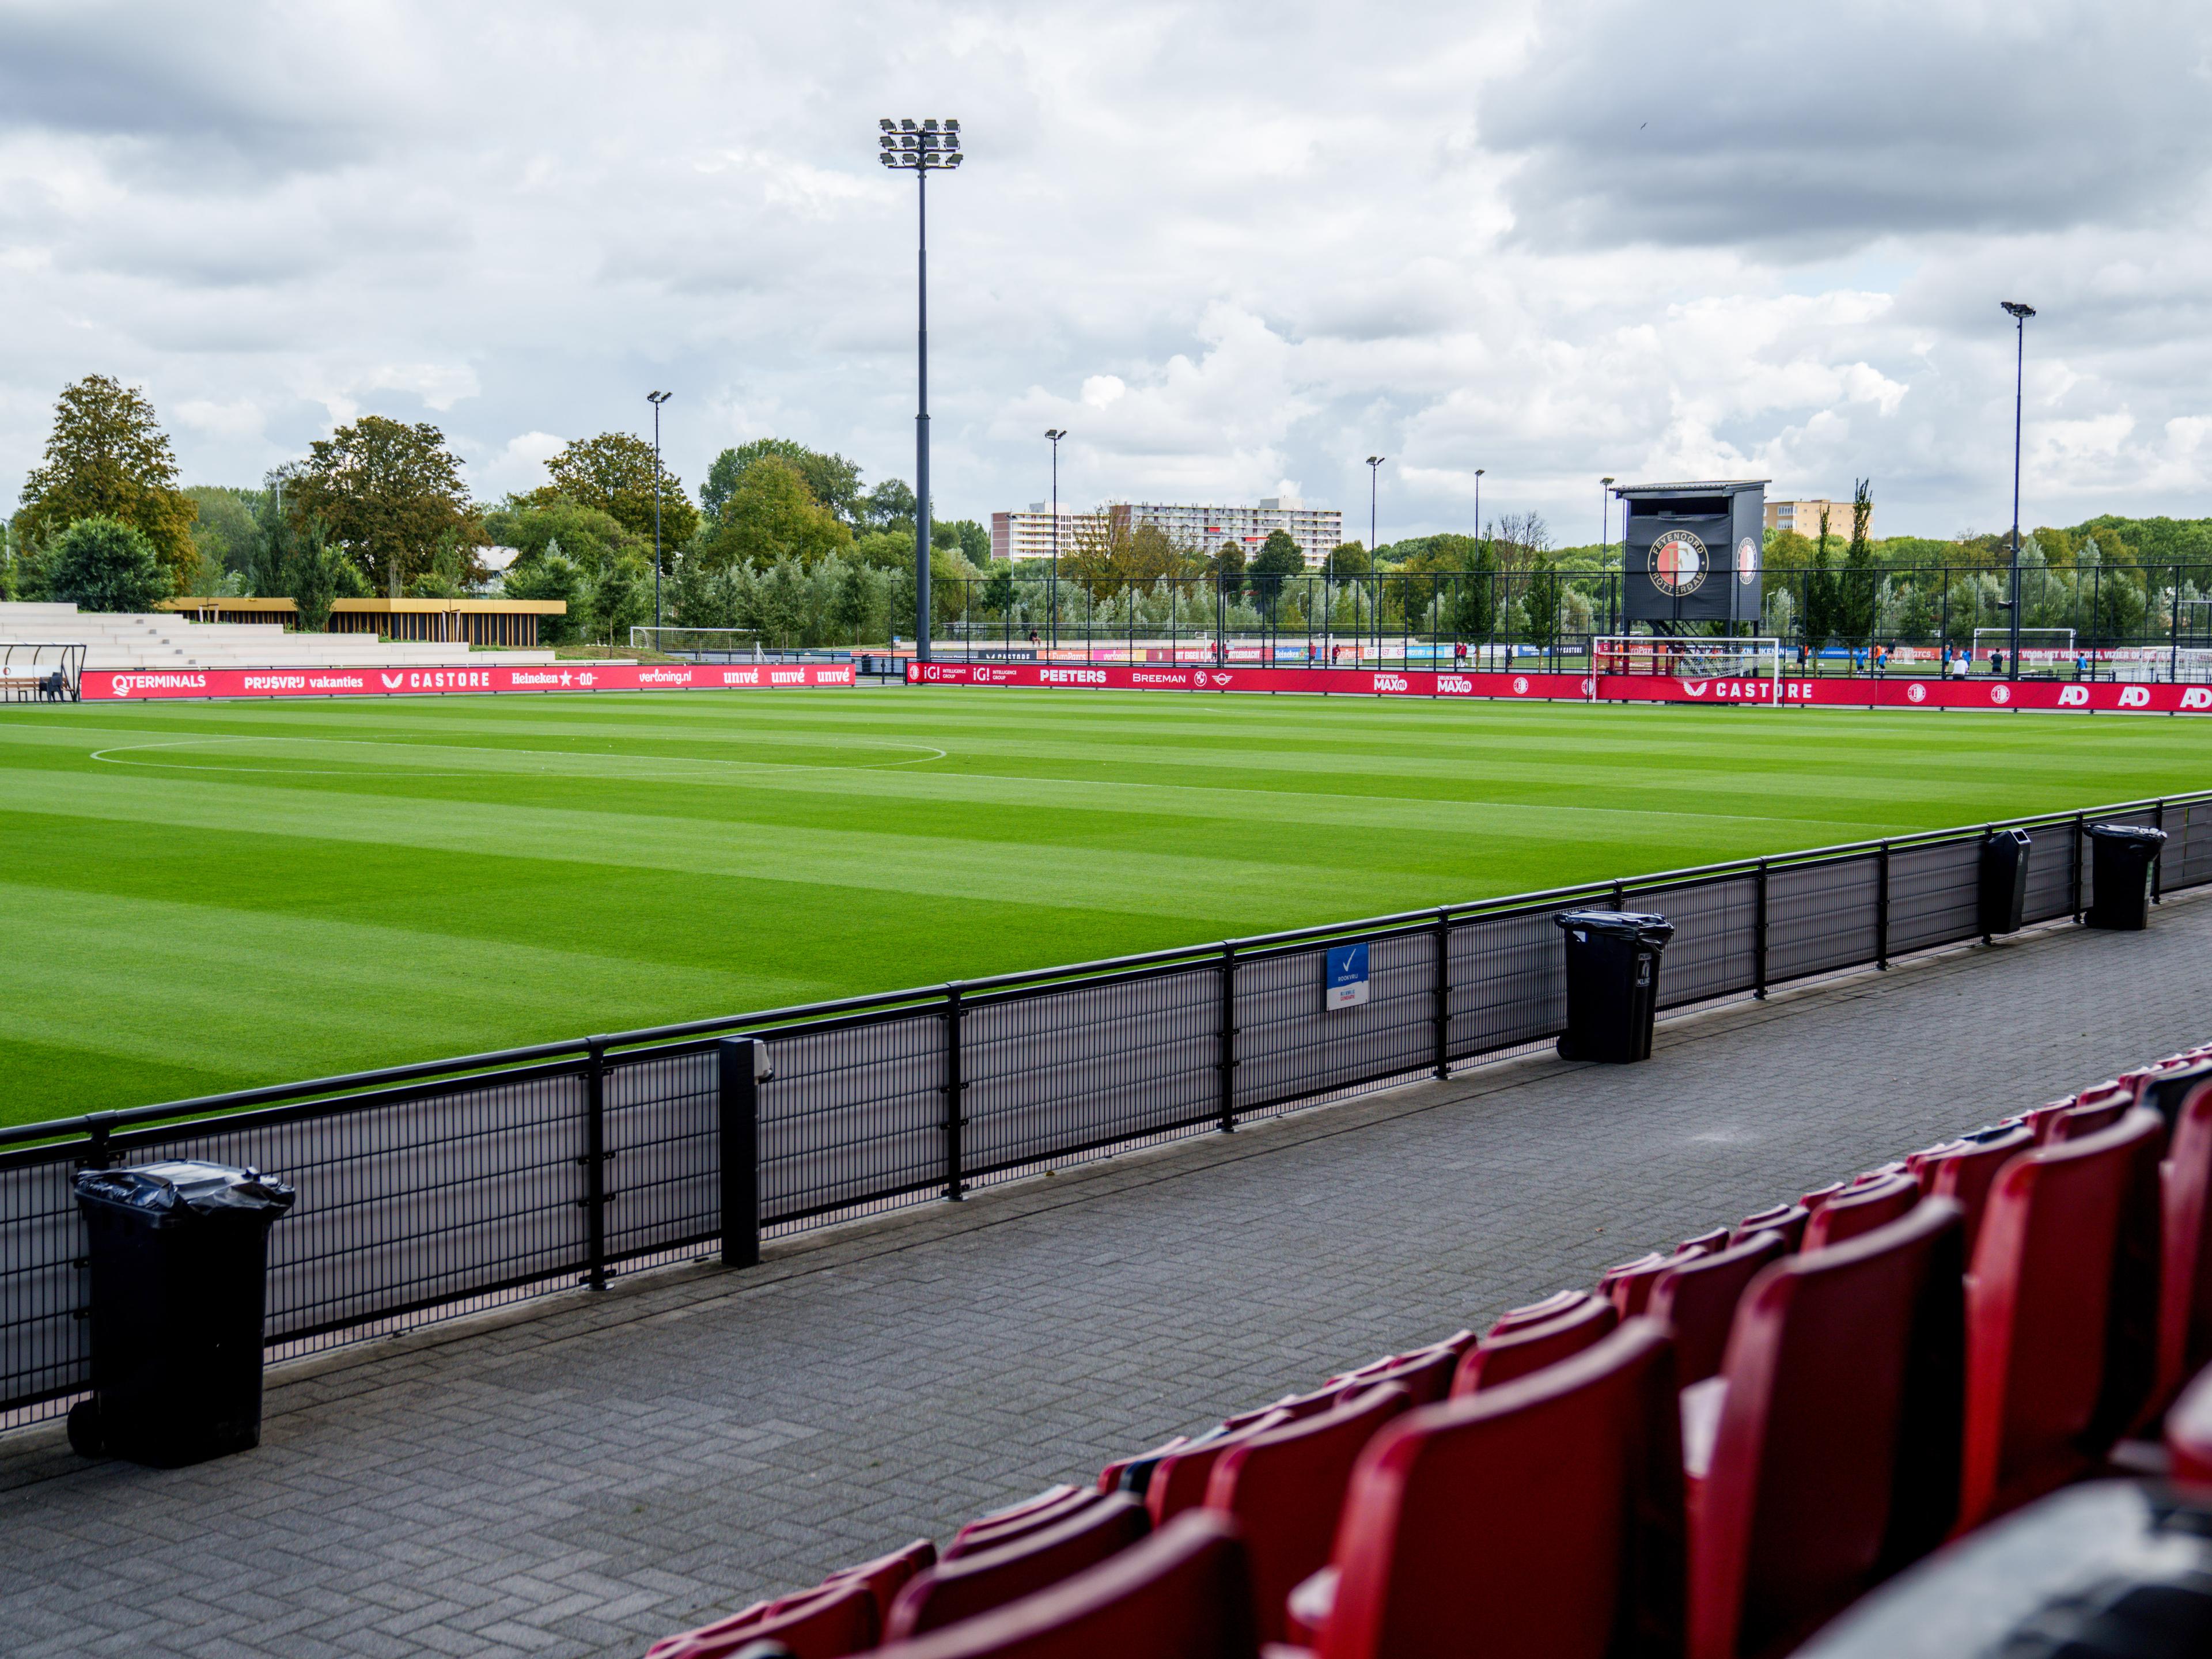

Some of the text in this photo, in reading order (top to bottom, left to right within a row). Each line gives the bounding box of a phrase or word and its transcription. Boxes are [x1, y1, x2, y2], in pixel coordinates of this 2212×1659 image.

[1652, 532, 1704, 555] FEYENOORD
[1652, 571, 1705, 594] ROTTERDAM
[309, 676, 363, 688] vakanties
[411, 672, 489, 688] CASTORE
[512, 672, 558, 684] Heineken
[724, 668, 759, 684] univé
[771, 667, 805, 683] univé
[817, 667, 850, 683] univé
[1040, 669, 1107, 683] PEETERS
[1132, 673, 1186, 683] BREEMAN
[112, 674, 206, 696] QTERMINALS
[1716, 683, 1813, 698] CASTORE
[2058, 685, 2089, 706] AD
[2118, 687, 2150, 707] AD
[2179, 688, 2212, 709] AD
[1338, 973, 1358, 982] ROOKVRIJ
